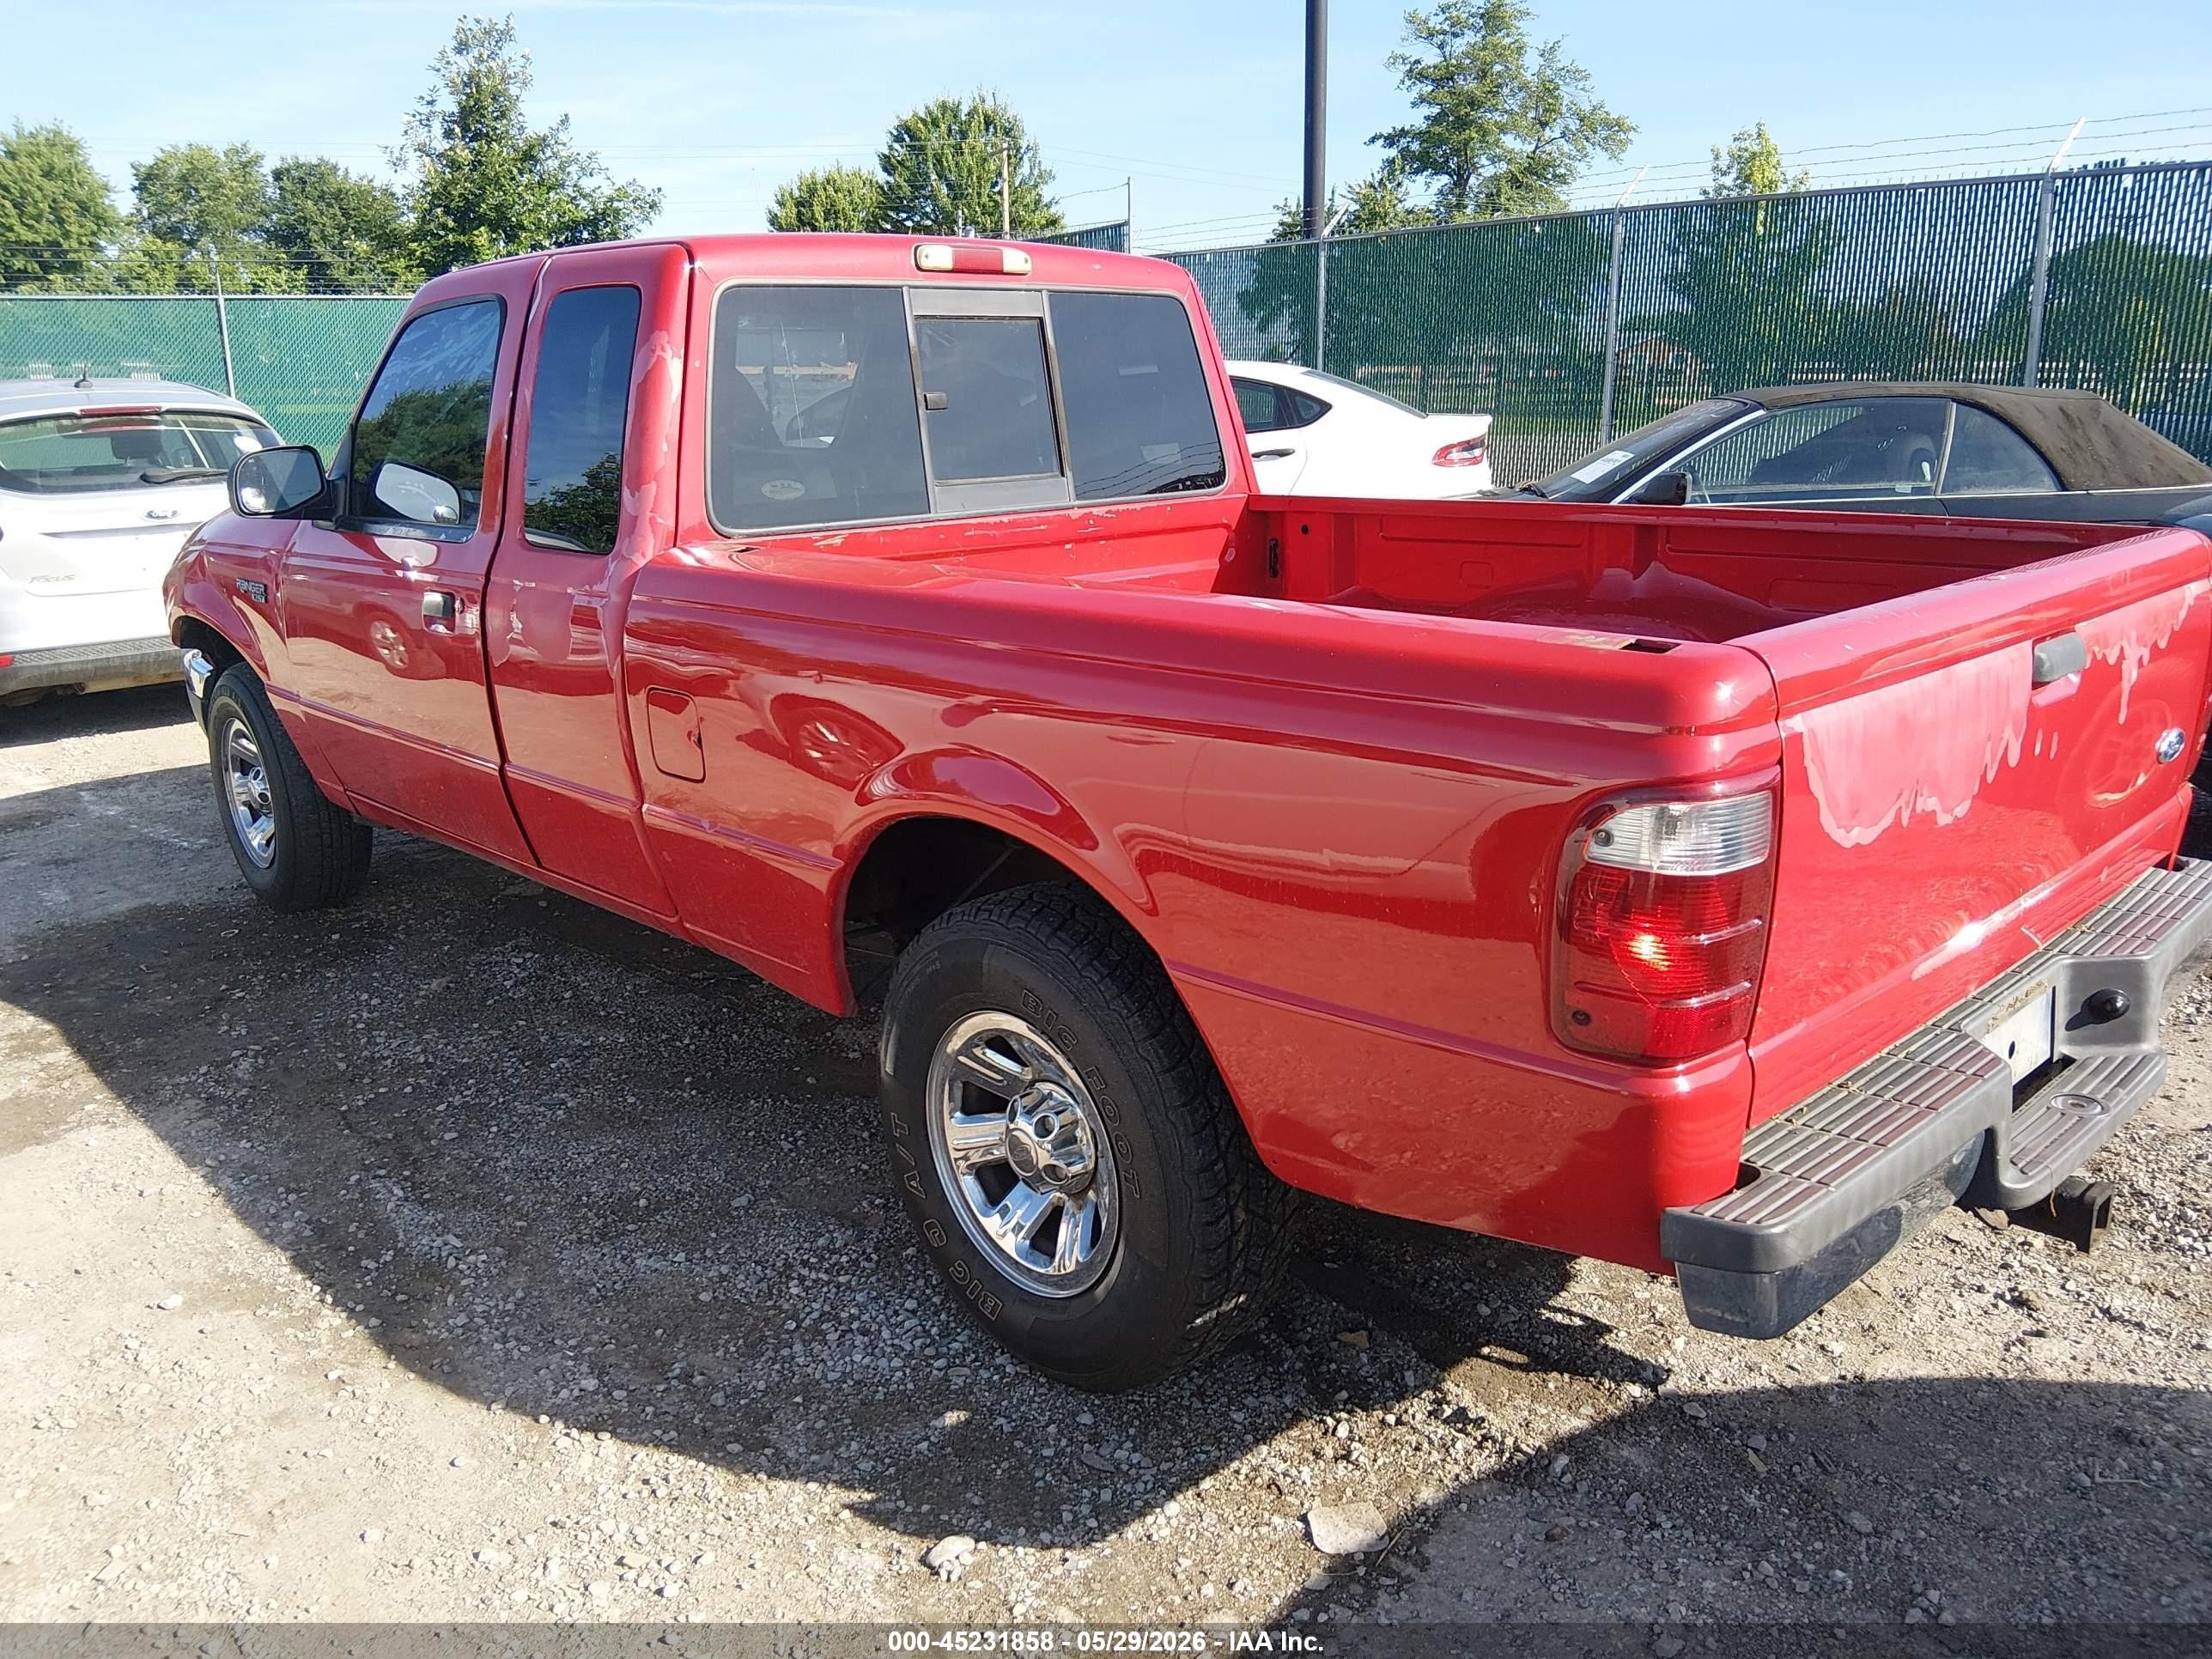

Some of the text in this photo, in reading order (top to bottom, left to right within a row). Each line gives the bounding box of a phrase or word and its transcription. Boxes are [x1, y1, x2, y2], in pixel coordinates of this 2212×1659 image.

[234, 577, 267, 596] RANGER
[1020, 988, 1141, 1199] BIG FOOT
[890, 1111, 927, 1199] A/T
[948, 1259, 1004, 1322] BIG
